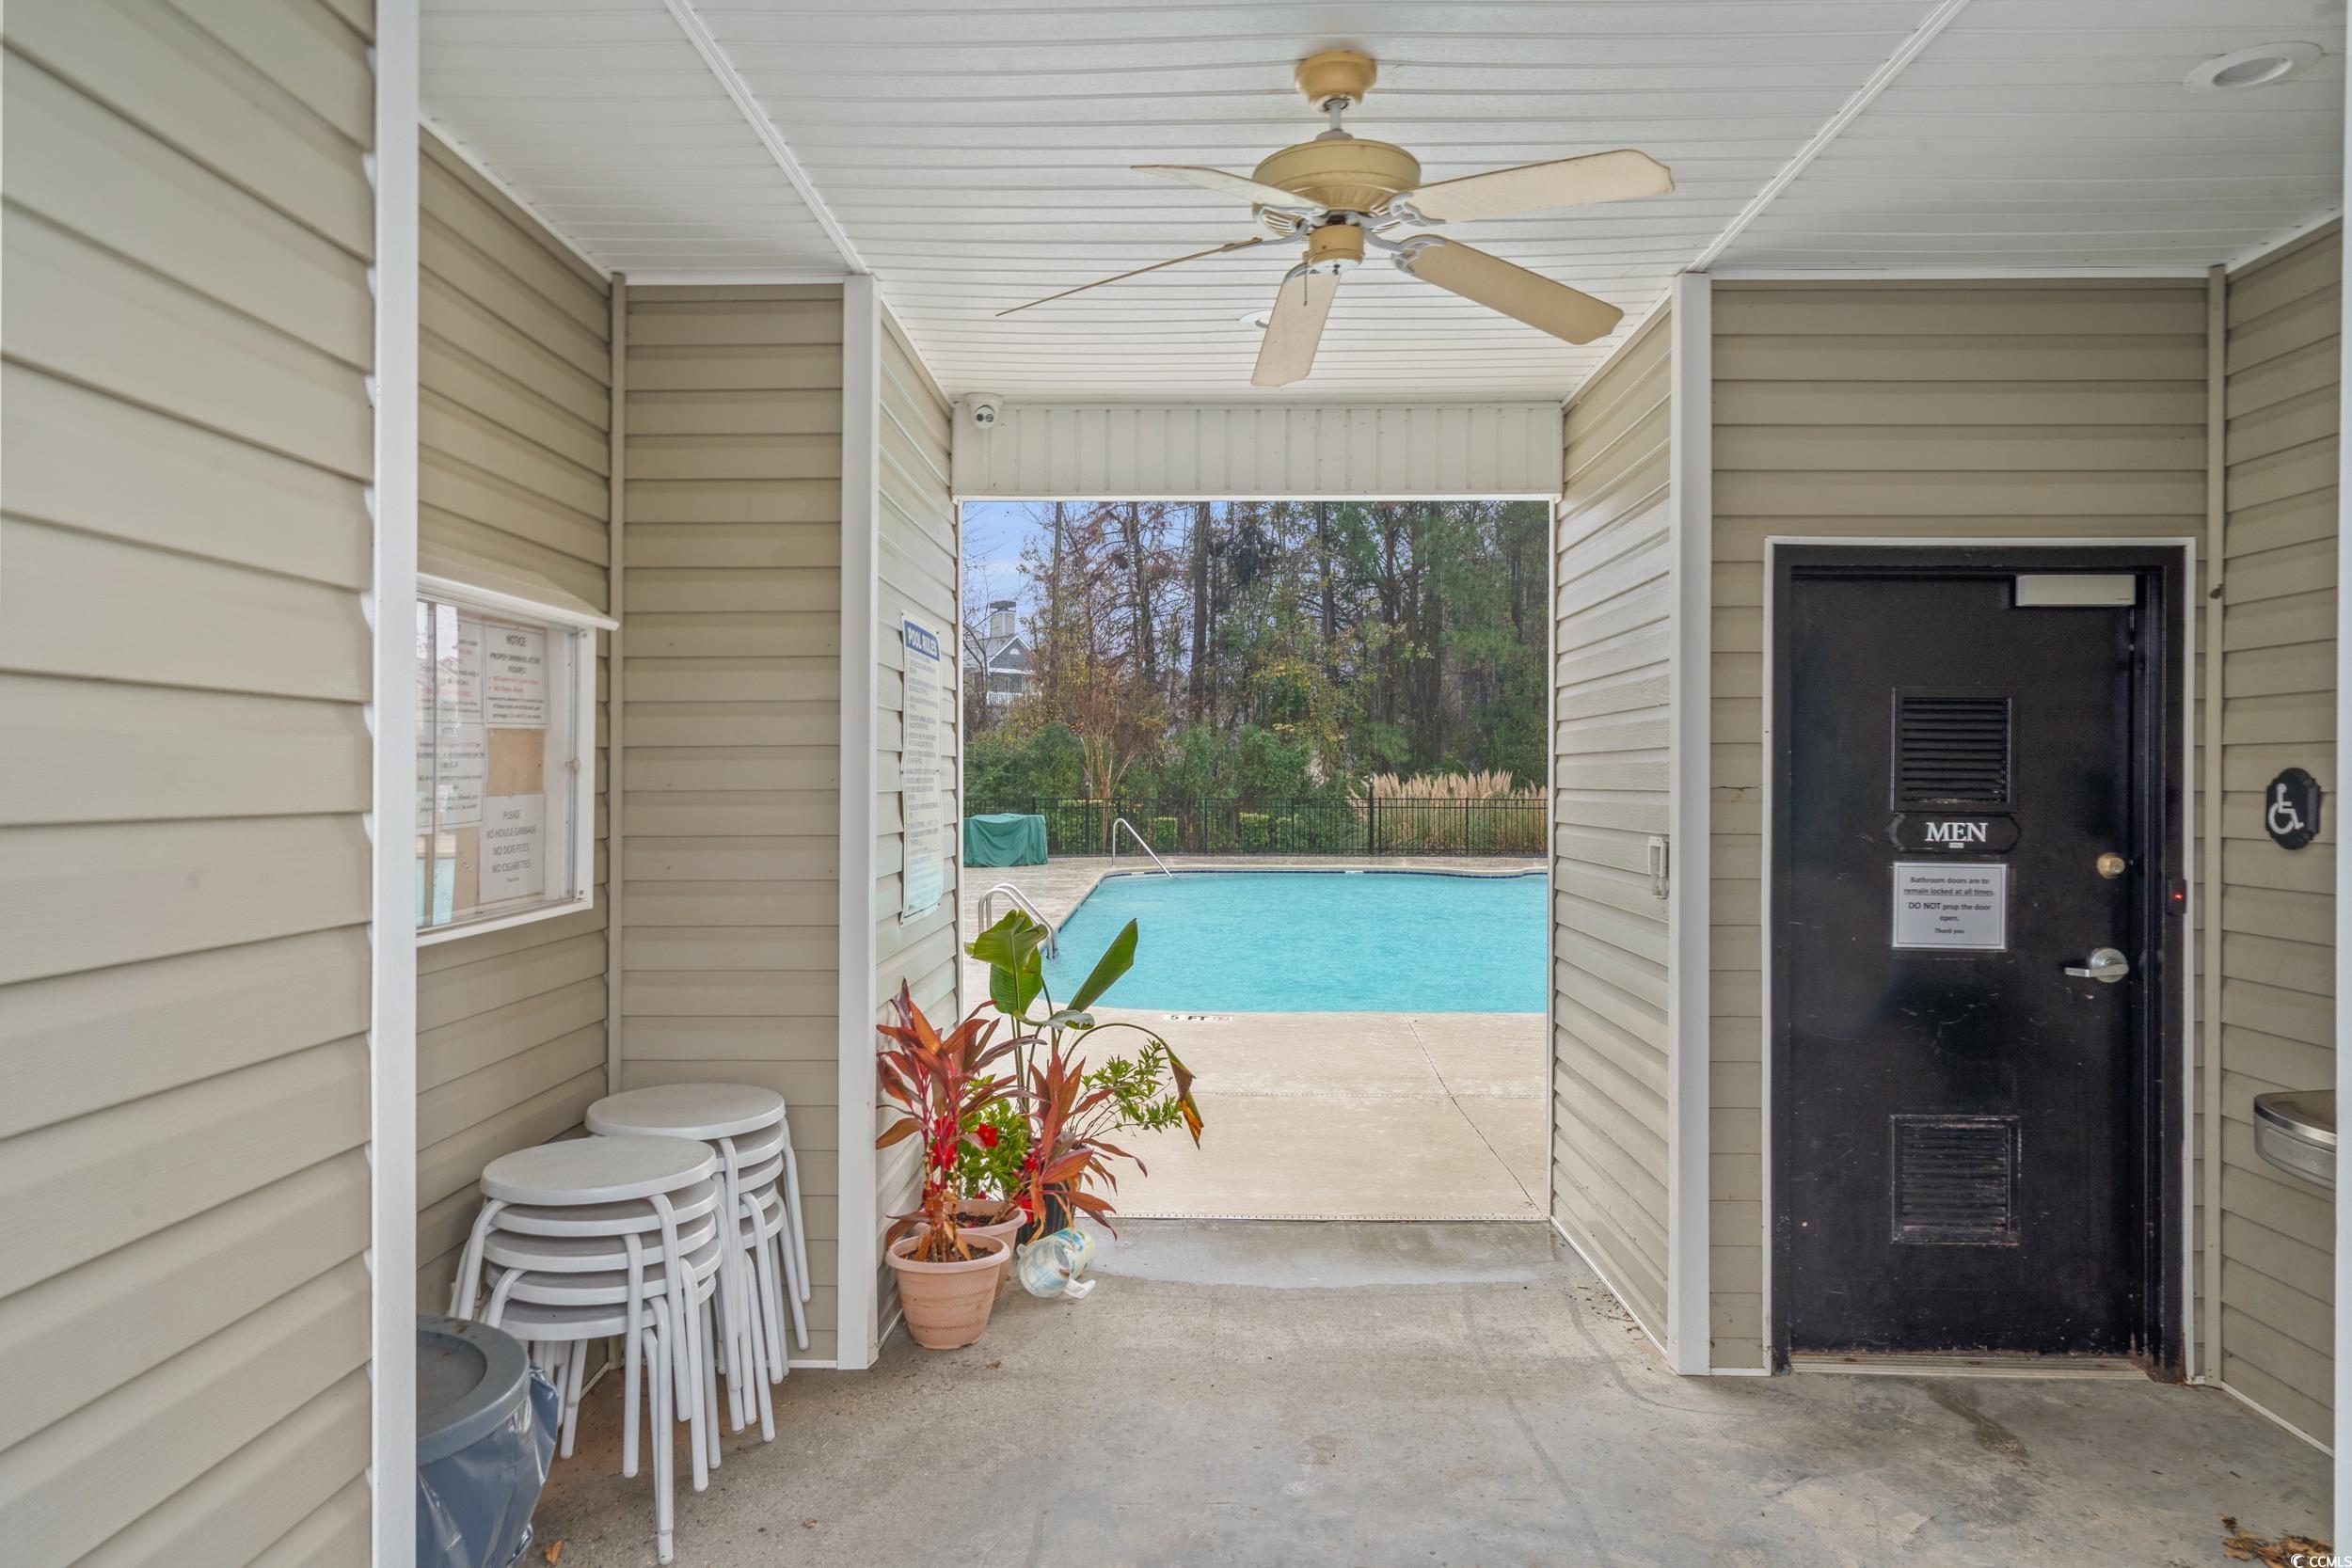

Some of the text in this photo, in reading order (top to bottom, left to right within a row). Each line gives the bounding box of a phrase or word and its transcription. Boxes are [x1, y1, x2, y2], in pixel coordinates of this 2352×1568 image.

[908, 627, 937, 657] POOL RULES
[503, 810, 520, 820] PLEASE
[486, 829, 495, 839] NO
[1924, 821, 1989, 843] MEN
[493, 846, 502, 855] NO
[503, 845, 516, 855] DOG
[491, 863, 501, 873] NO
[1923, 902, 1942, 911] NOT
